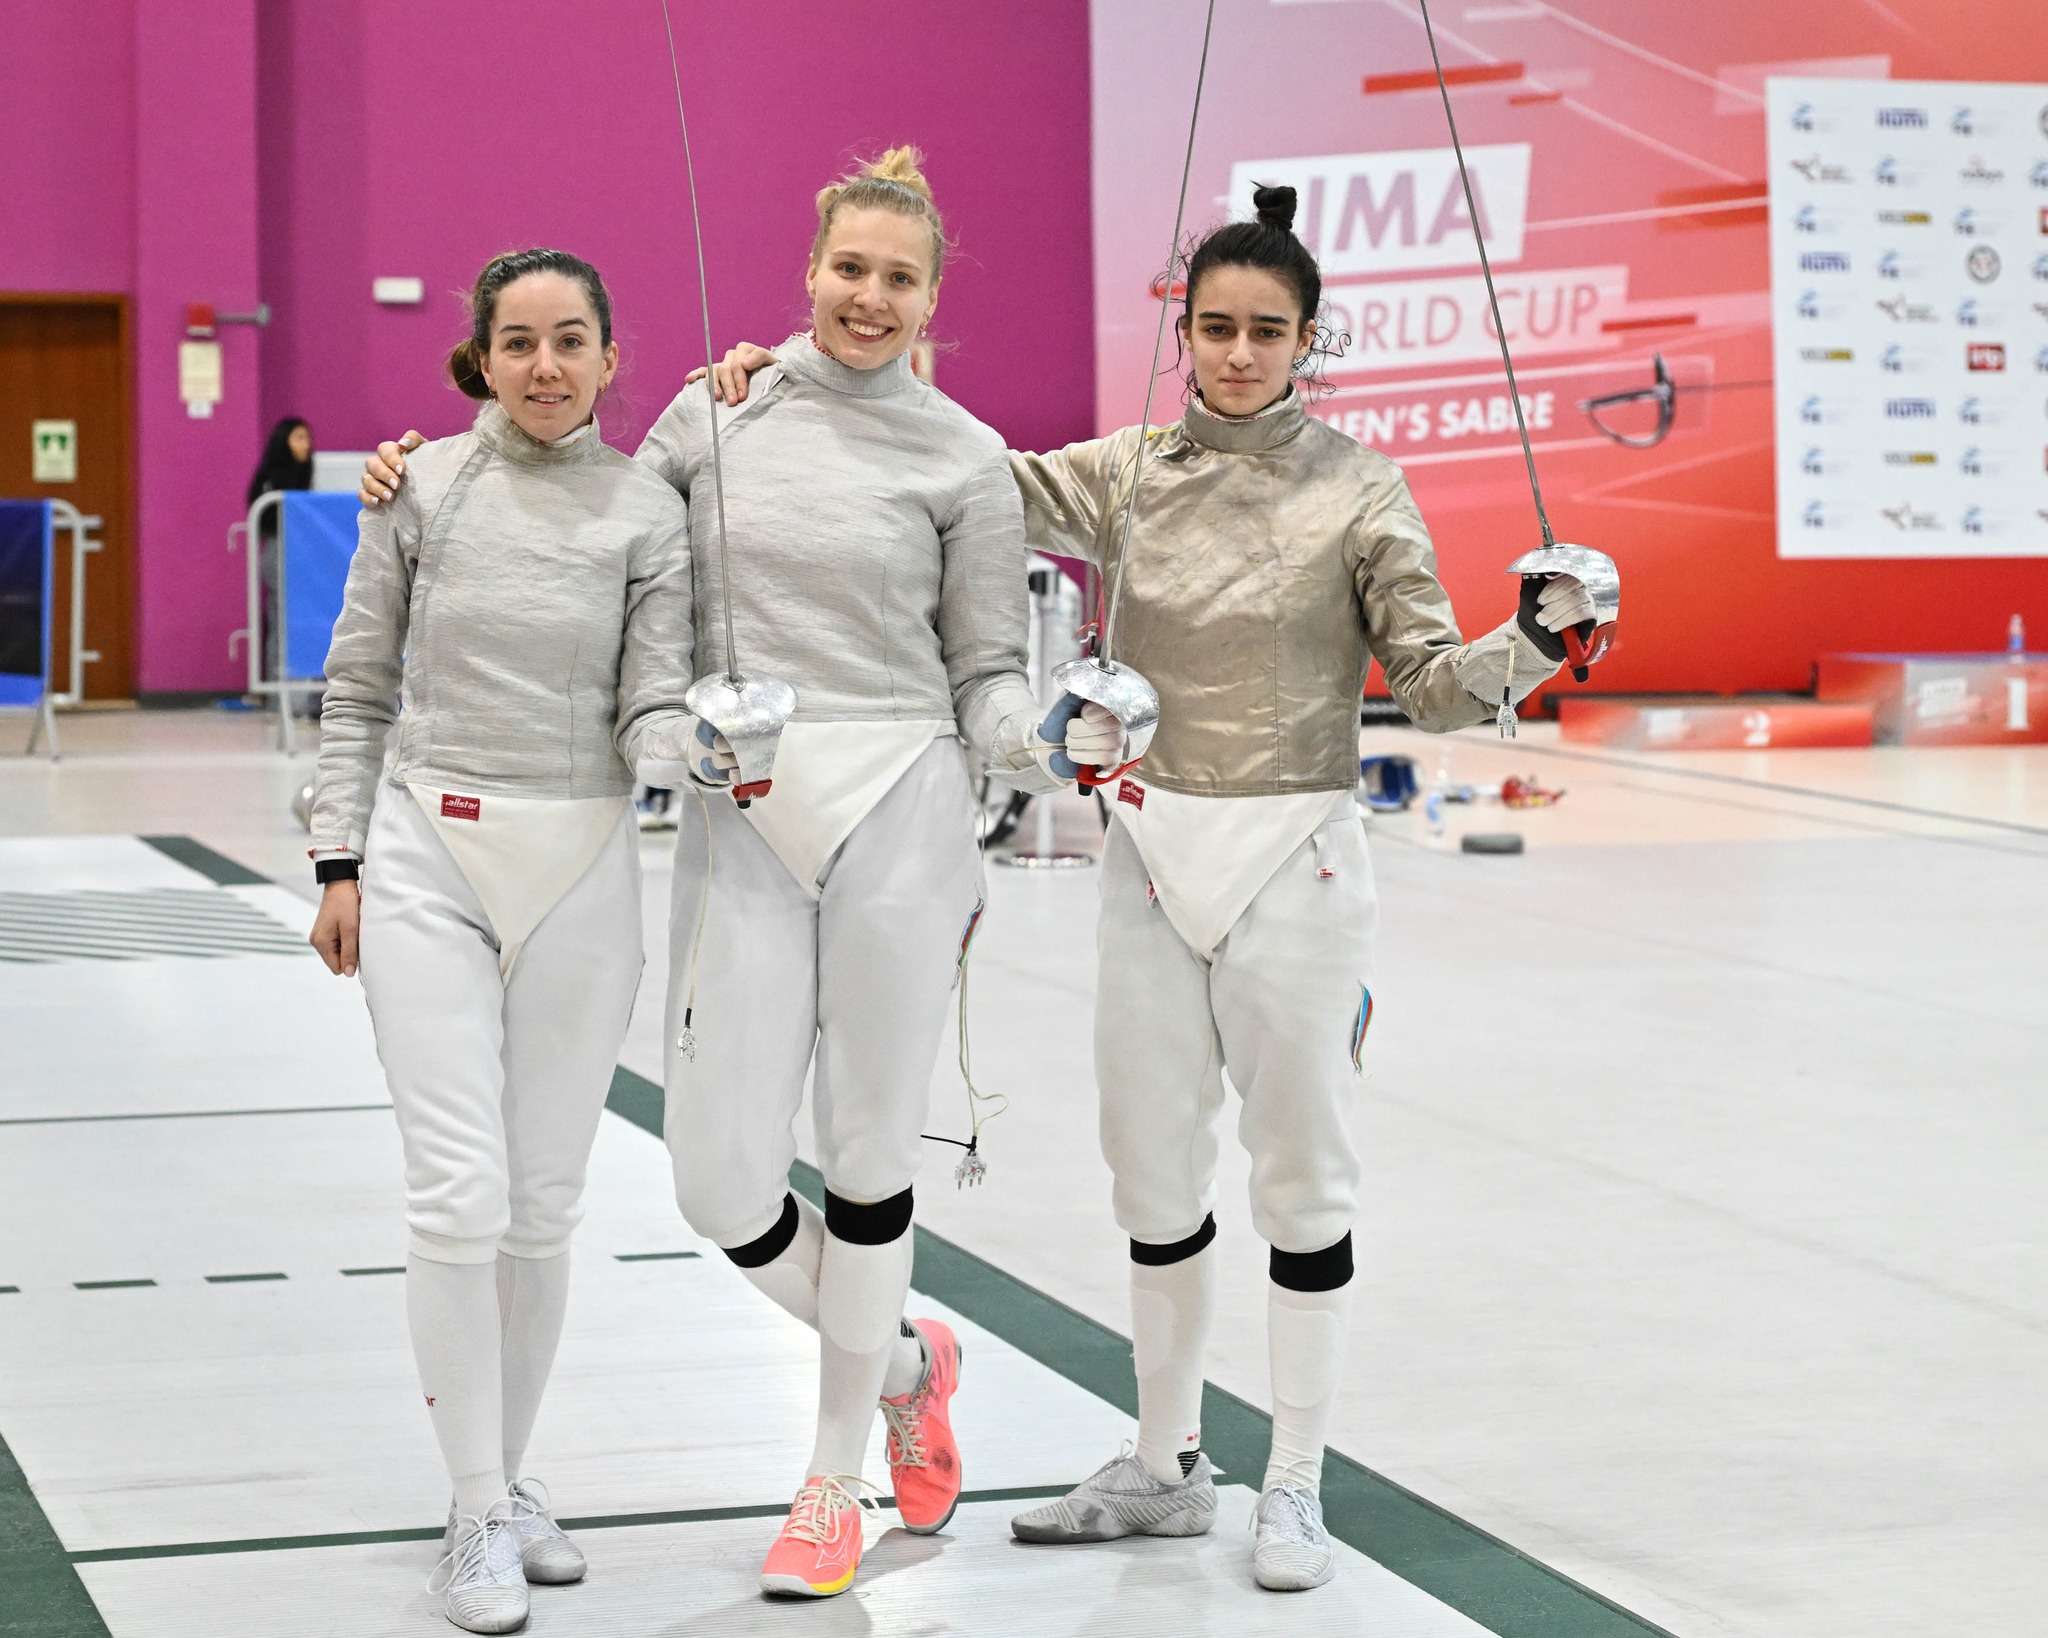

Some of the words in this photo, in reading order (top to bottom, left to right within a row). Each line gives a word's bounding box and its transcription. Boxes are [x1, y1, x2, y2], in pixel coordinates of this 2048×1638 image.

[1265, 165, 1494, 253] IMA
[1317, 295, 1462, 355] ORLD
[1483, 283, 1598, 342] CUP
[1437, 392, 1554, 441] SABRE
[1744, 710, 1771, 746] 2
[2007, 676, 2029, 731] 1
[447, 797, 479, 810] allstar
